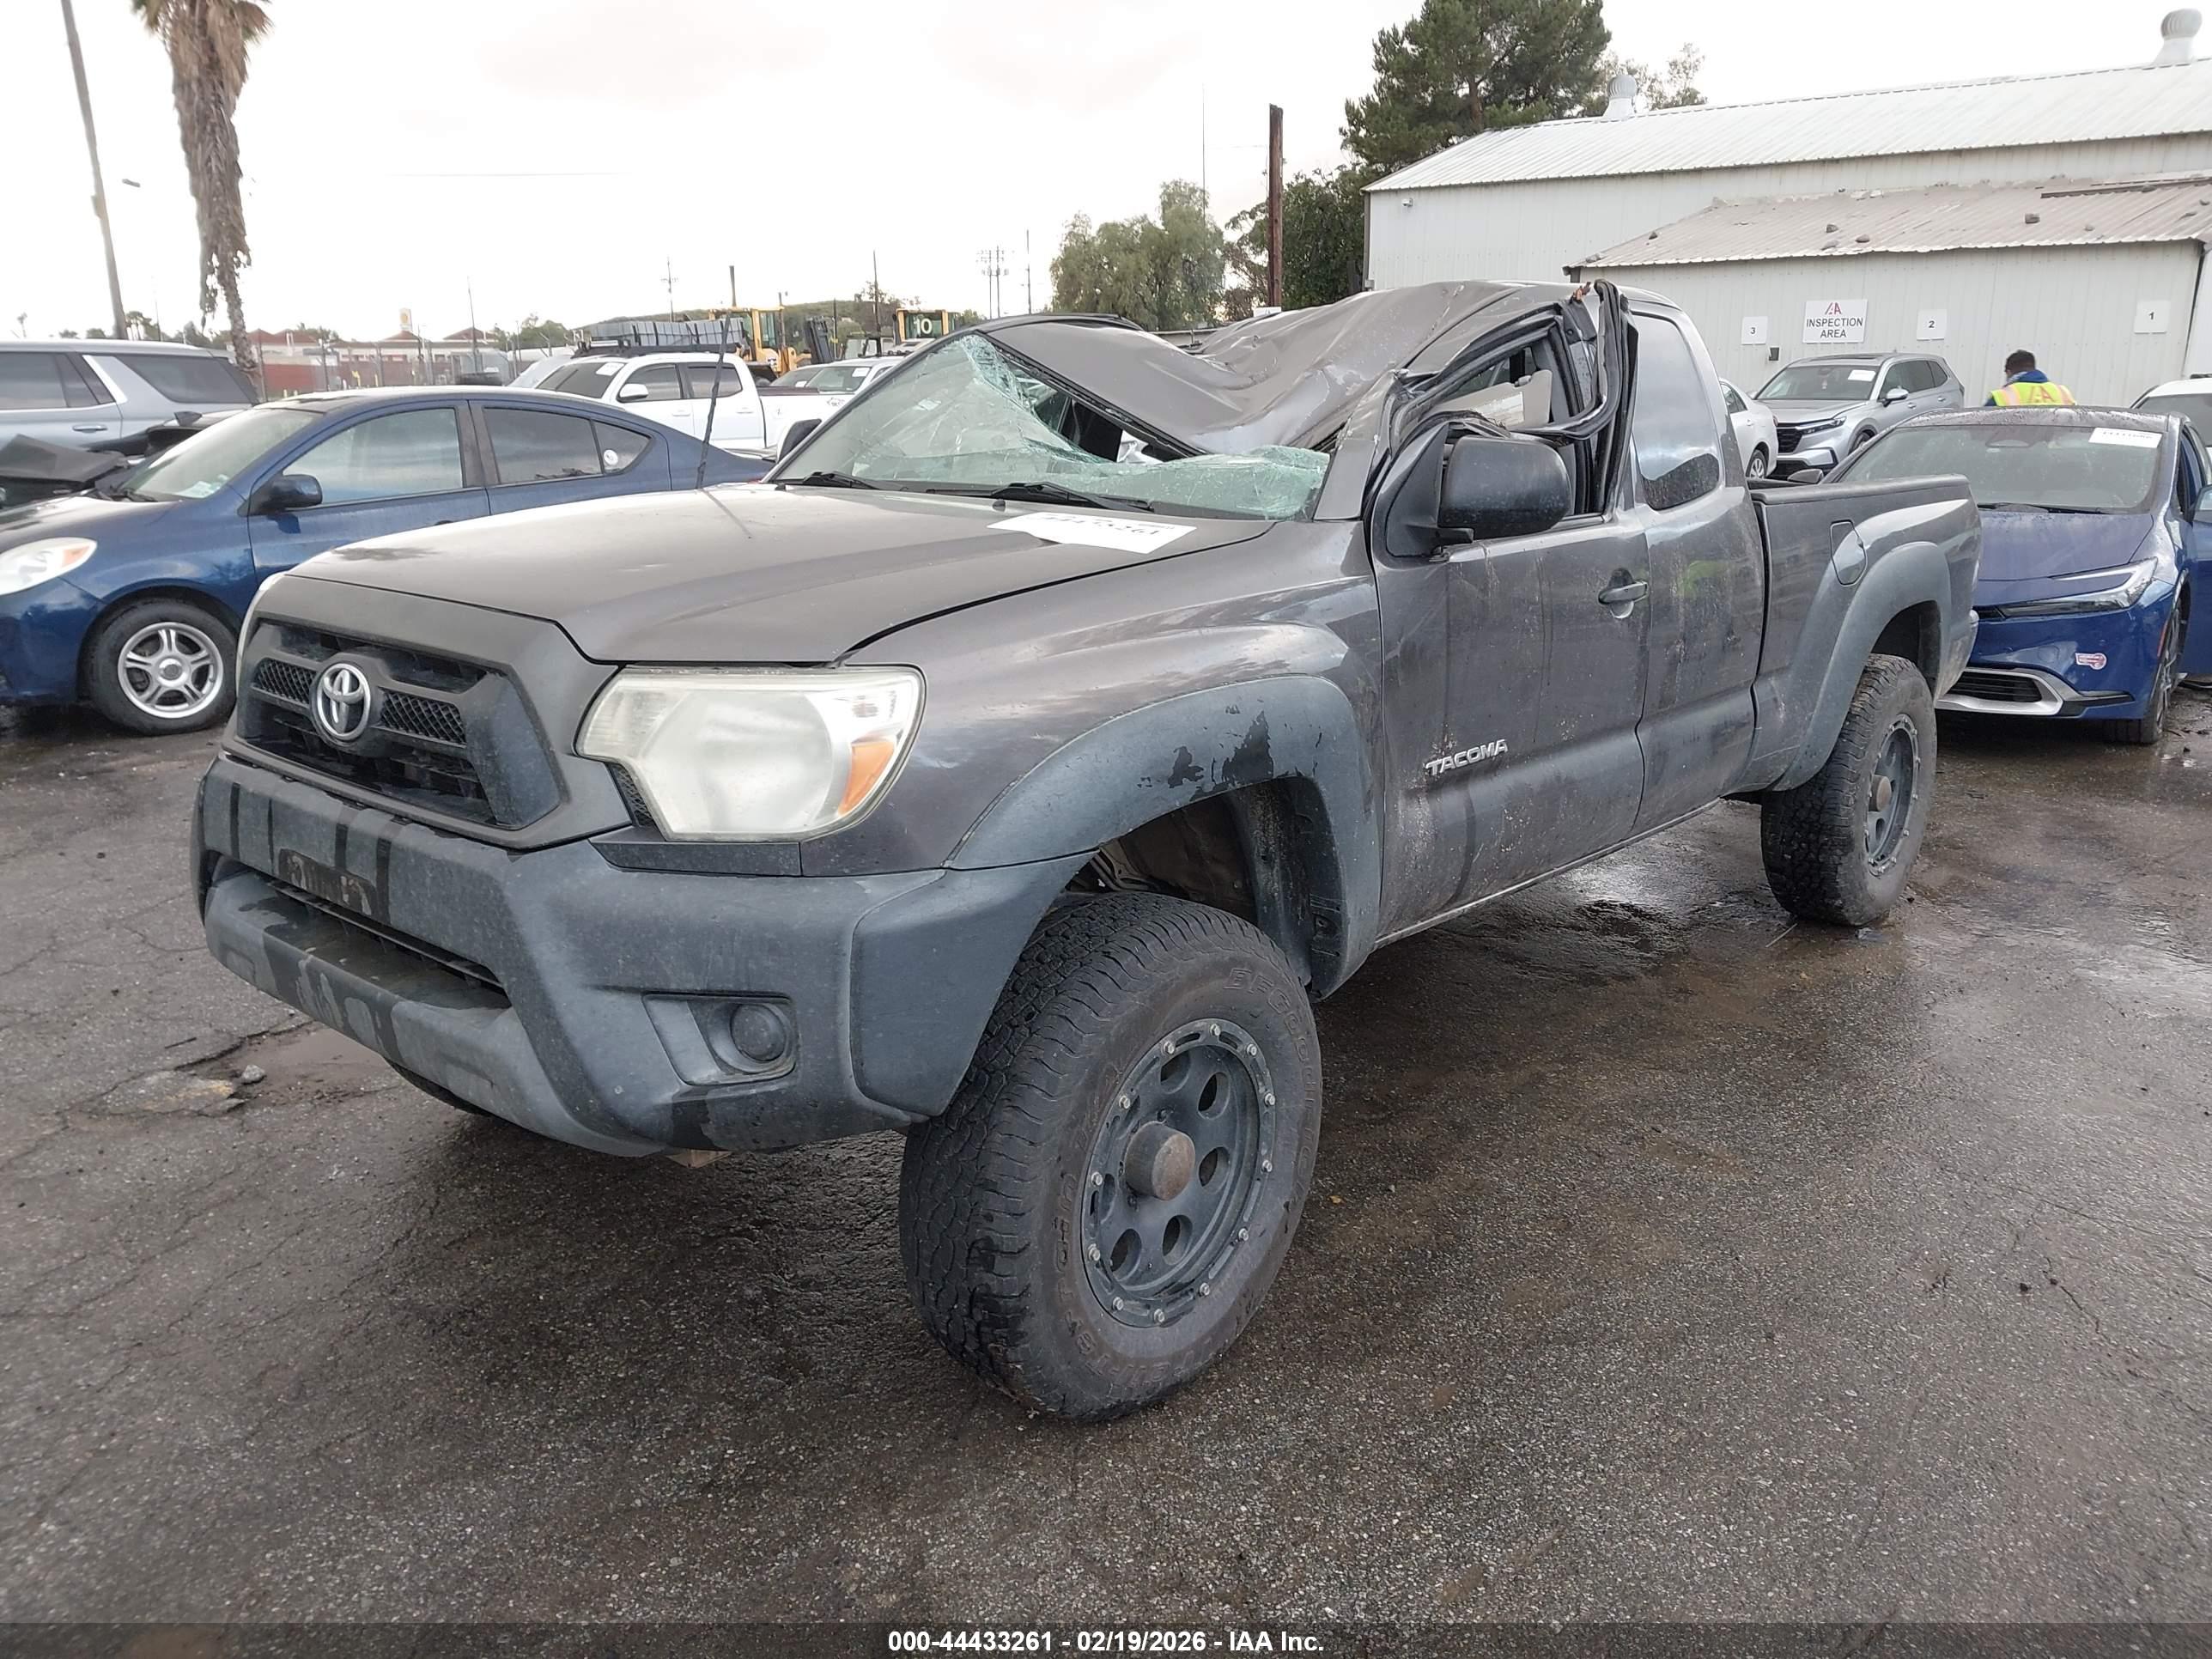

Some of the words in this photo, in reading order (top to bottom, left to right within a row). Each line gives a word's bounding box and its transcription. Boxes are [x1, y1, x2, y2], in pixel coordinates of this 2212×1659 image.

[2148, 312, 2154, 320] 1
[913, 315, 933, 336] 10
[1806, 317, 1863, 327] INSPECTION
[1820, 329, 1846, 338] AREA
[1425, 739, 1509, 775] TACOMA
